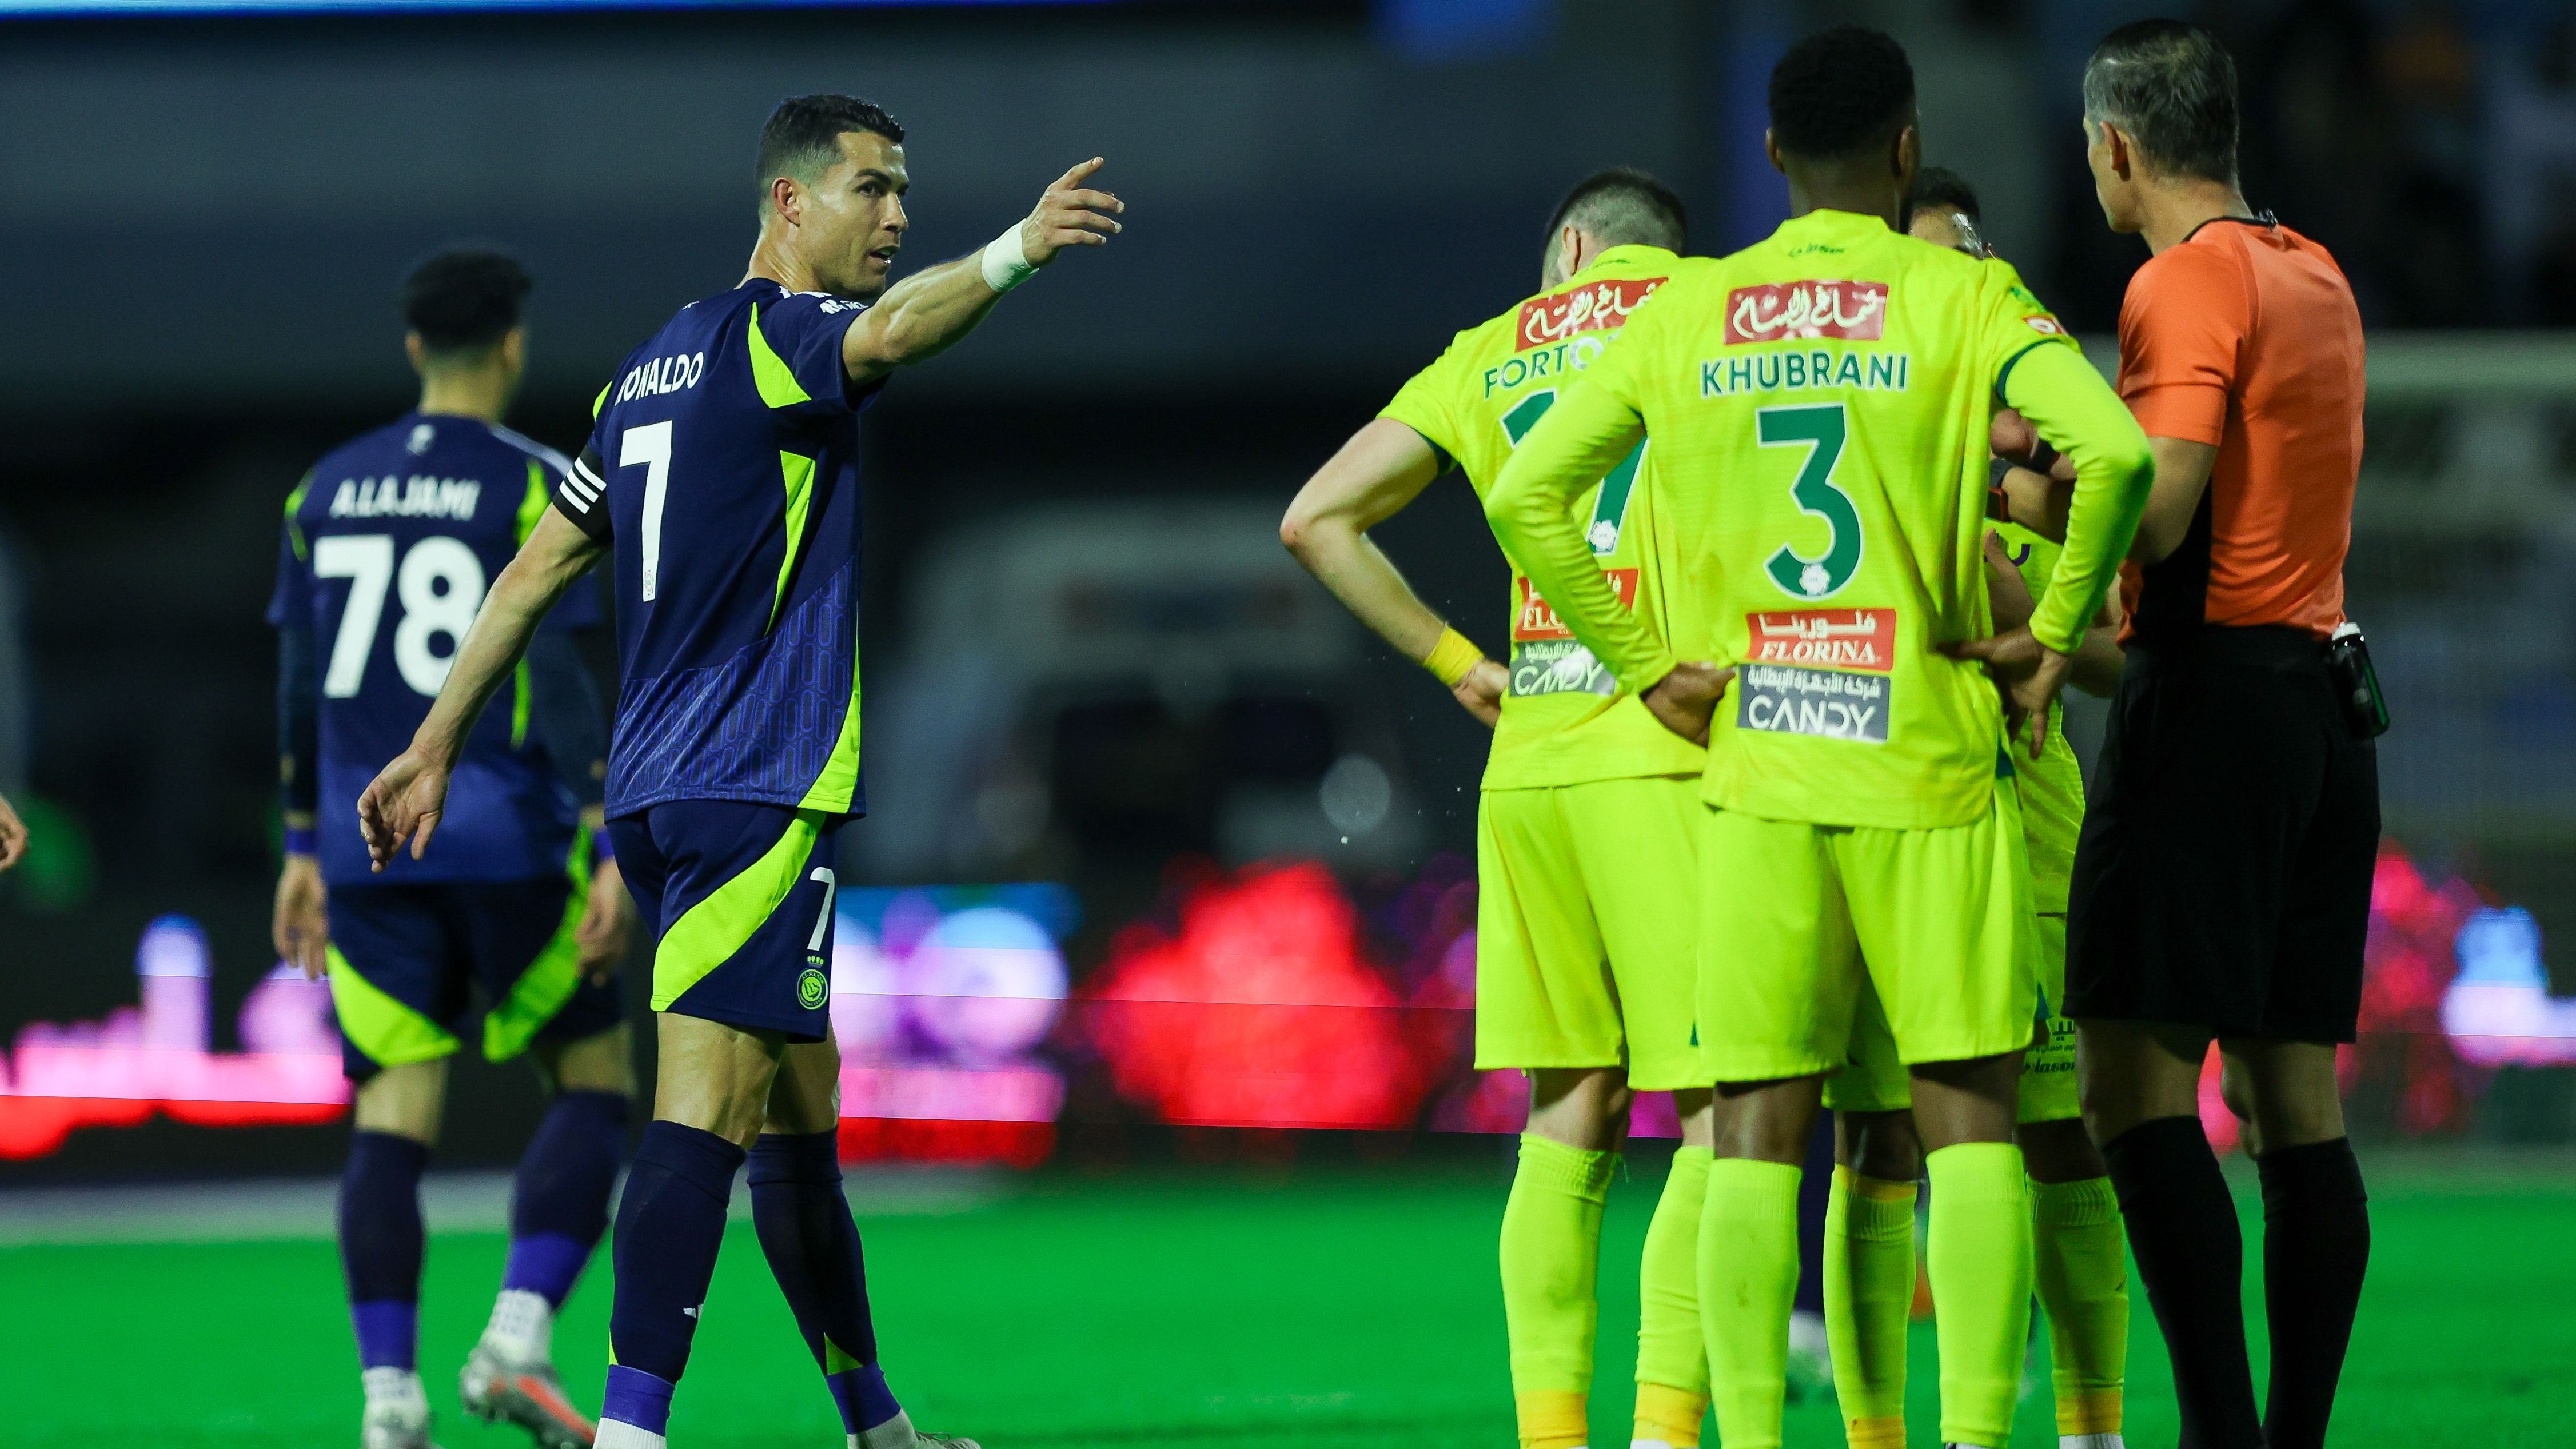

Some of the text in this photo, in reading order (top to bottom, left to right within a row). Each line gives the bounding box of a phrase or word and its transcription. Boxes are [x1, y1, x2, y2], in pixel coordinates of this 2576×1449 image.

[1483, 329, 1622, 401] FORTO
[1701, 349, 1909, 398] KHUBRANI
[619, 420, 673, 602] 7
[1756, 404, 1862, 601] 3
[314, 534, 486, 698] 78
[1760, 640, 1876, 664] FLORINA
[1748, 694, 1876, 737] CANDY
[807, 867, 835, 951] 7
